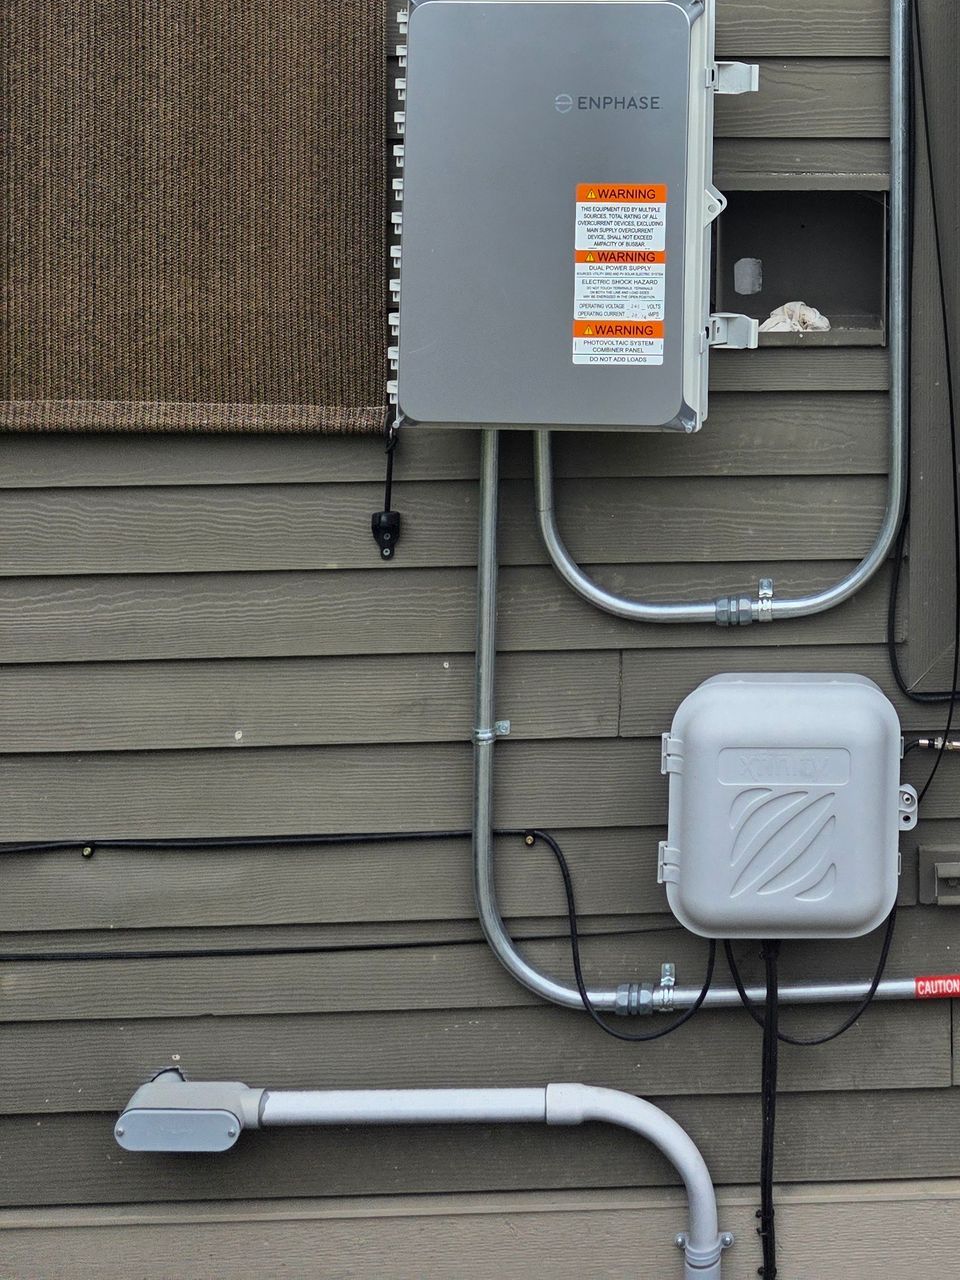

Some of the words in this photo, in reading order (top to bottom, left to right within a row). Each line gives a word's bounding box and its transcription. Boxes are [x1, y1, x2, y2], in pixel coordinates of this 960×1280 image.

[578, 96, 660, 110] ENPHASE
[598, 189, 656, 199] WARNING
[598, 252, 655, 262] WARNING
[595, 326, 653, 335] WARNING
[918, 980, 960, 995] CAUTION
